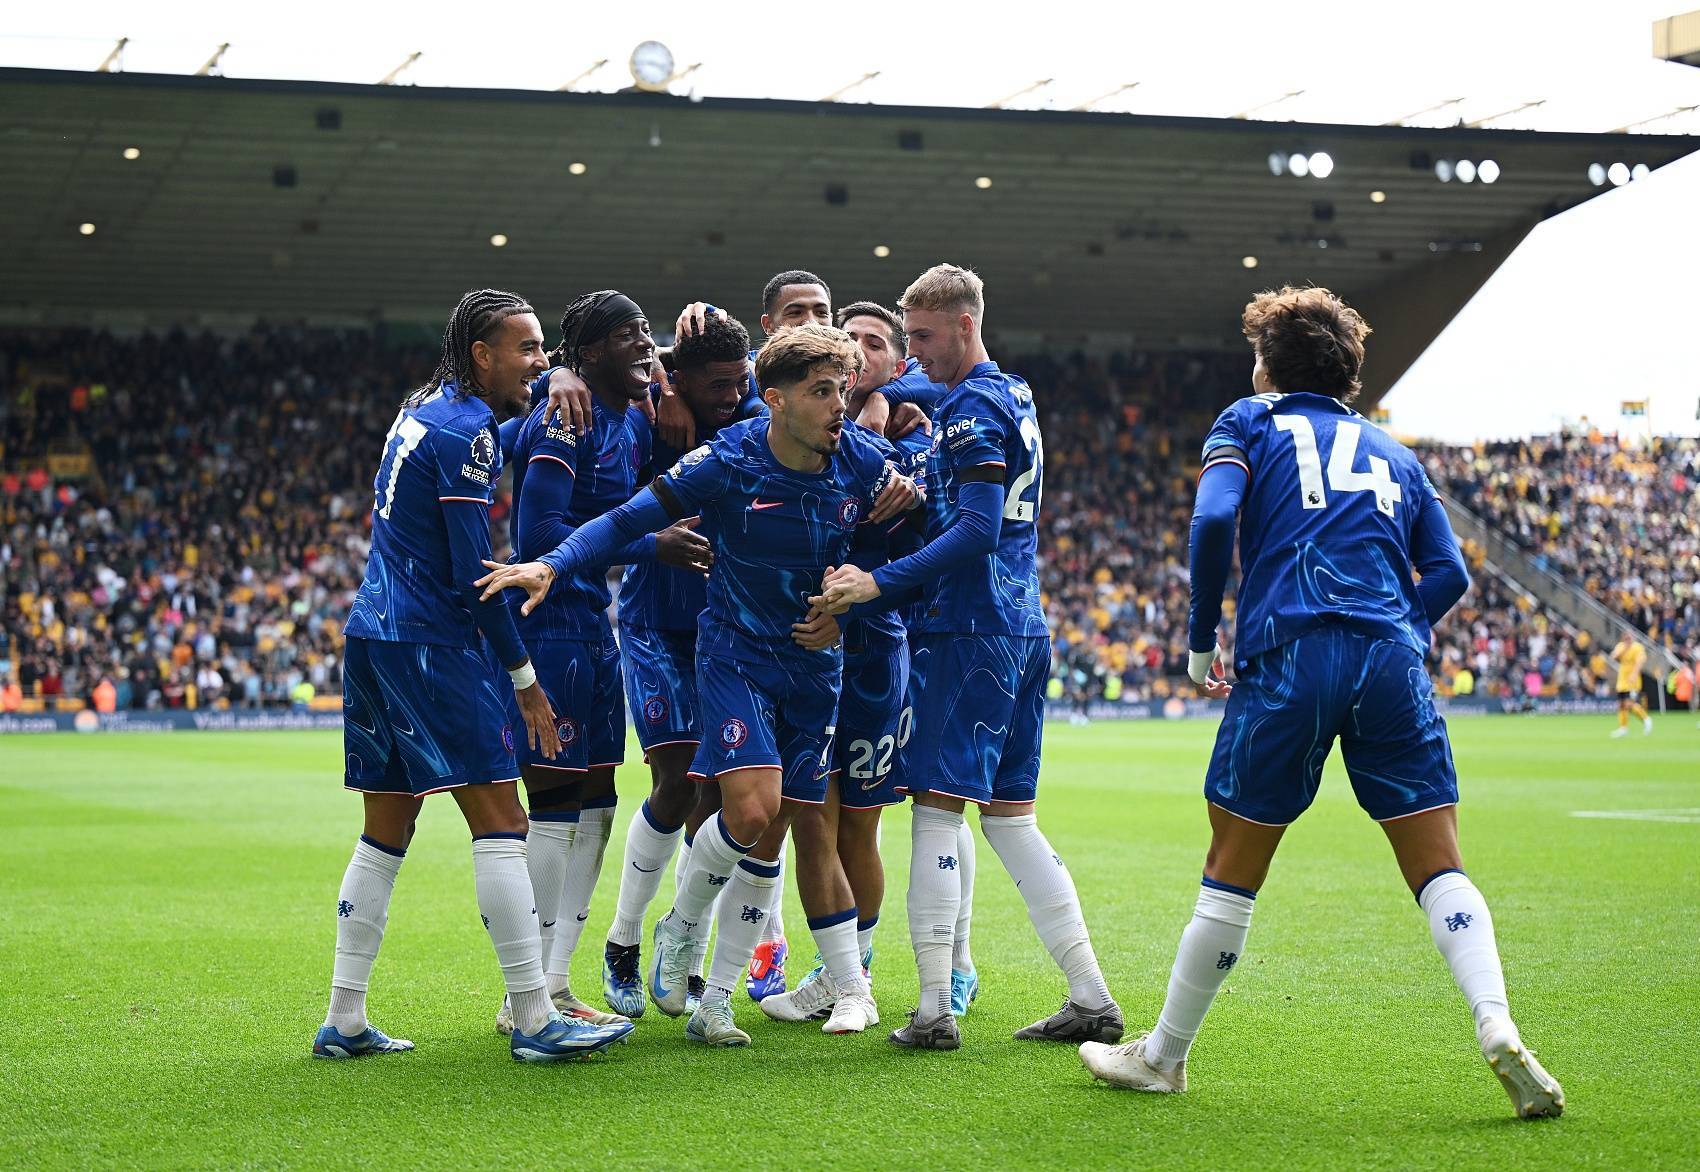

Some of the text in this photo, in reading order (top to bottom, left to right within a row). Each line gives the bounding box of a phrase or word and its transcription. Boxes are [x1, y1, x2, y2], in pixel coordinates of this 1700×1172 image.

[1002, 416, 1044, 522] 2
[1273, 414, 1402, 518] 14
[819, 725, 836, 767] 7
